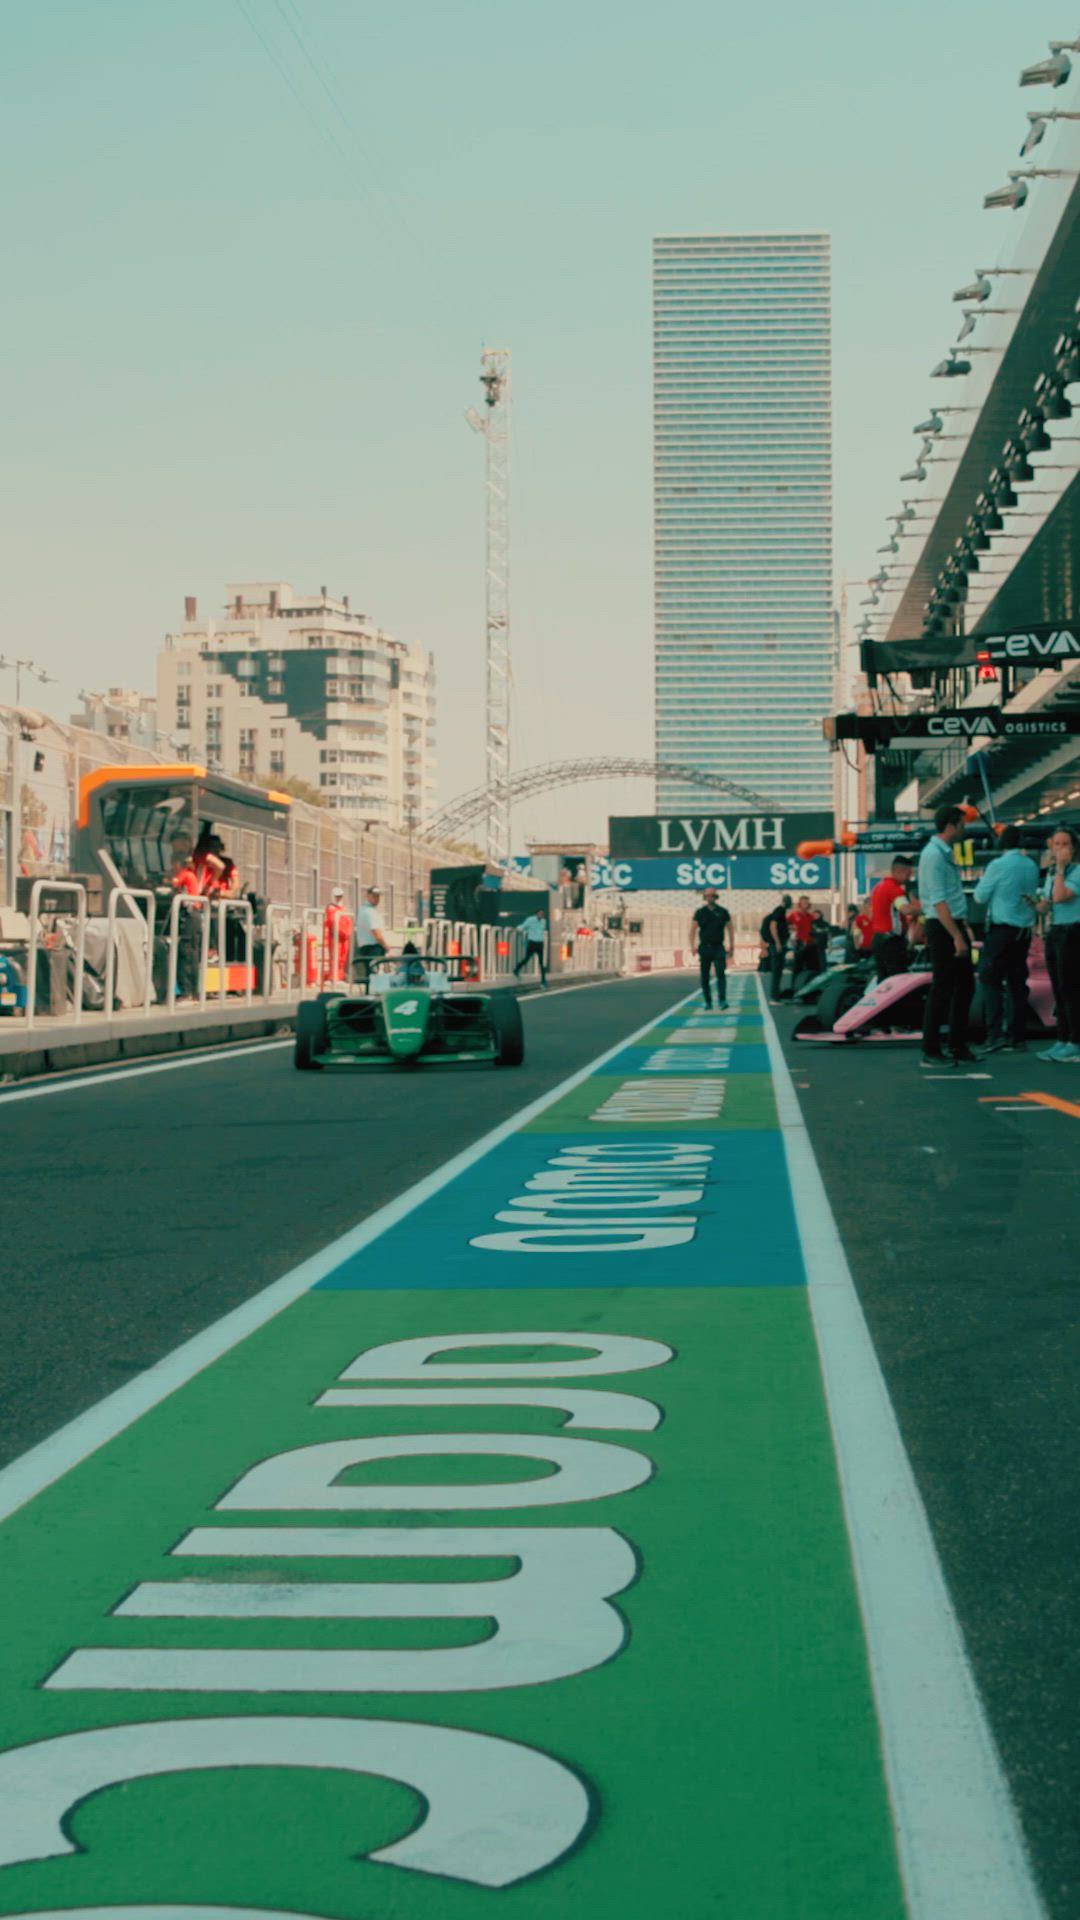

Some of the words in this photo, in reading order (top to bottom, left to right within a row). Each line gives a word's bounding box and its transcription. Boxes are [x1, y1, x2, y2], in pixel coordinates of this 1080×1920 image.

[658, 818, 785, 852] LVMH
[676, 858, 726, 885] stc
[769, 857, 820, 885] stc
[393, 1000, 418, 1016] 4
[468, 1143, 716, 1253] aramco
[0, 1331, 677, 1920] aramc
